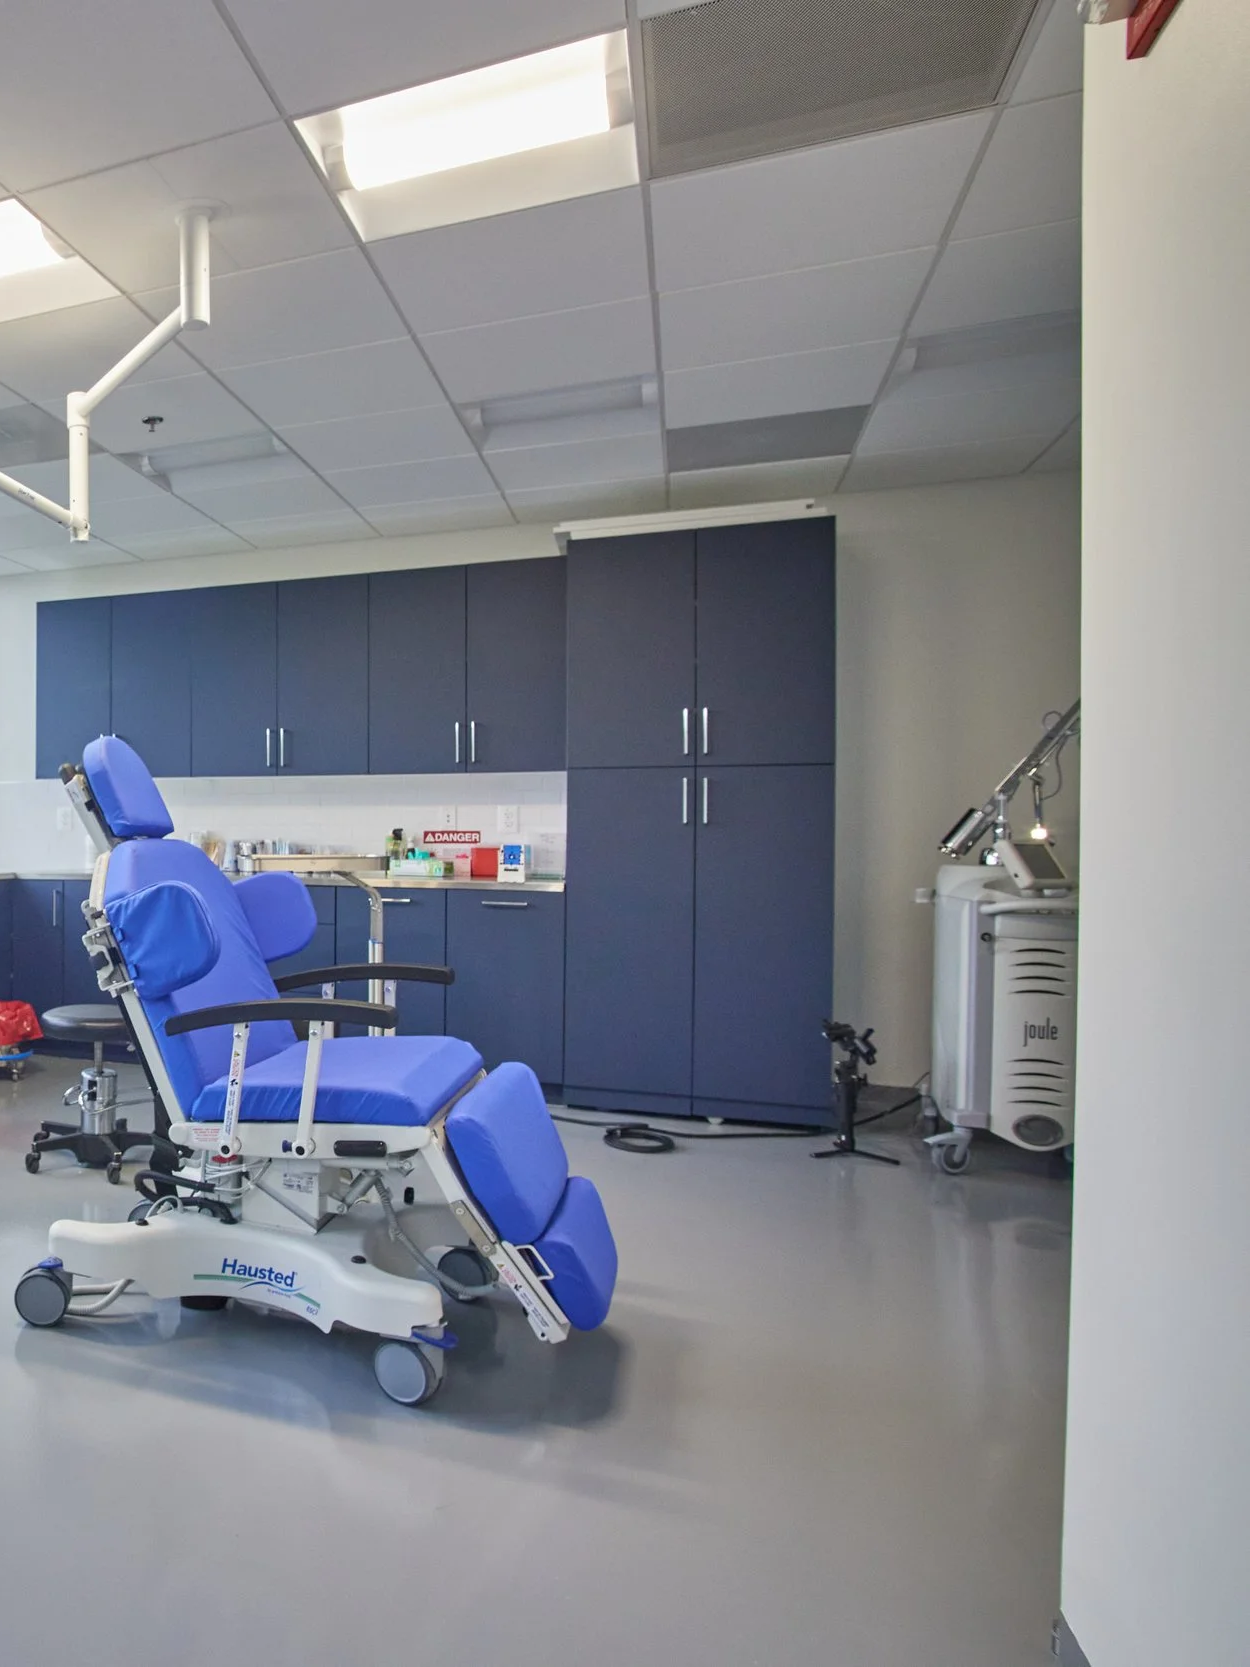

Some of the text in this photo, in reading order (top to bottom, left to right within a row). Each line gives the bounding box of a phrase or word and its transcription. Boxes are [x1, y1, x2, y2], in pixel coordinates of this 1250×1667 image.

[434, 832, 480, 842] DANGER
[1022, 1016, 1059, 1047] joule
[221, 1257, 296, 1288] Hausted
